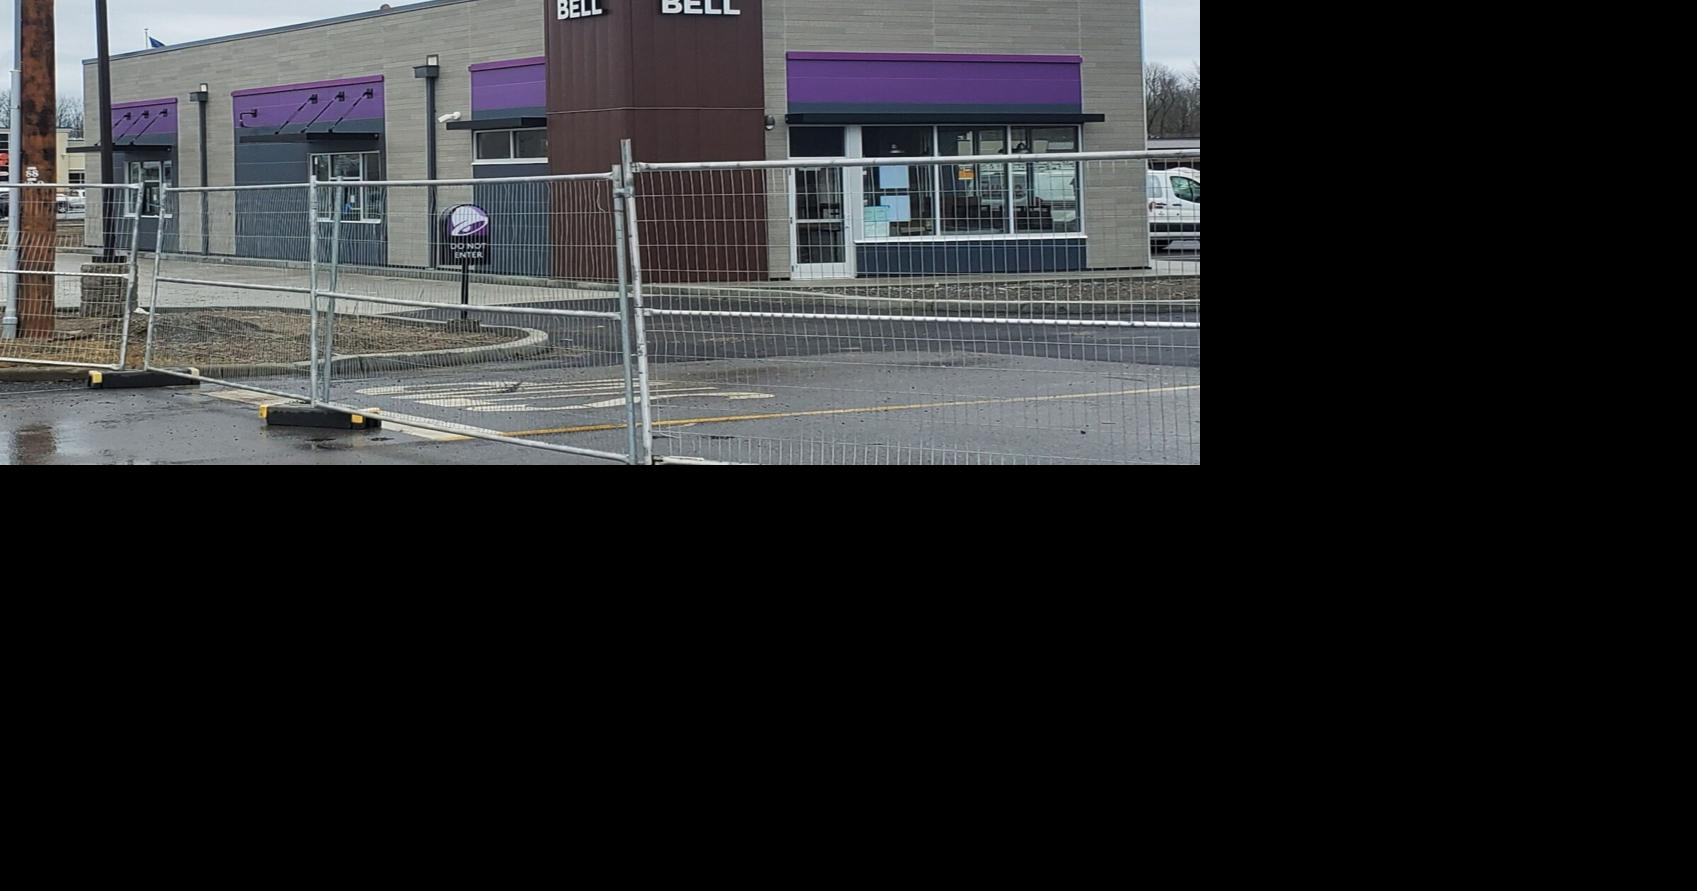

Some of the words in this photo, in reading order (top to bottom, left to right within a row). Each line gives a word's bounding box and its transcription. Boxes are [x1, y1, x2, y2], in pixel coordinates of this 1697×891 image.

[557, 0, 602, 20] BELL
[661, 0, 741, 15] BELL
[454, 251, 484, 259] ENTER
